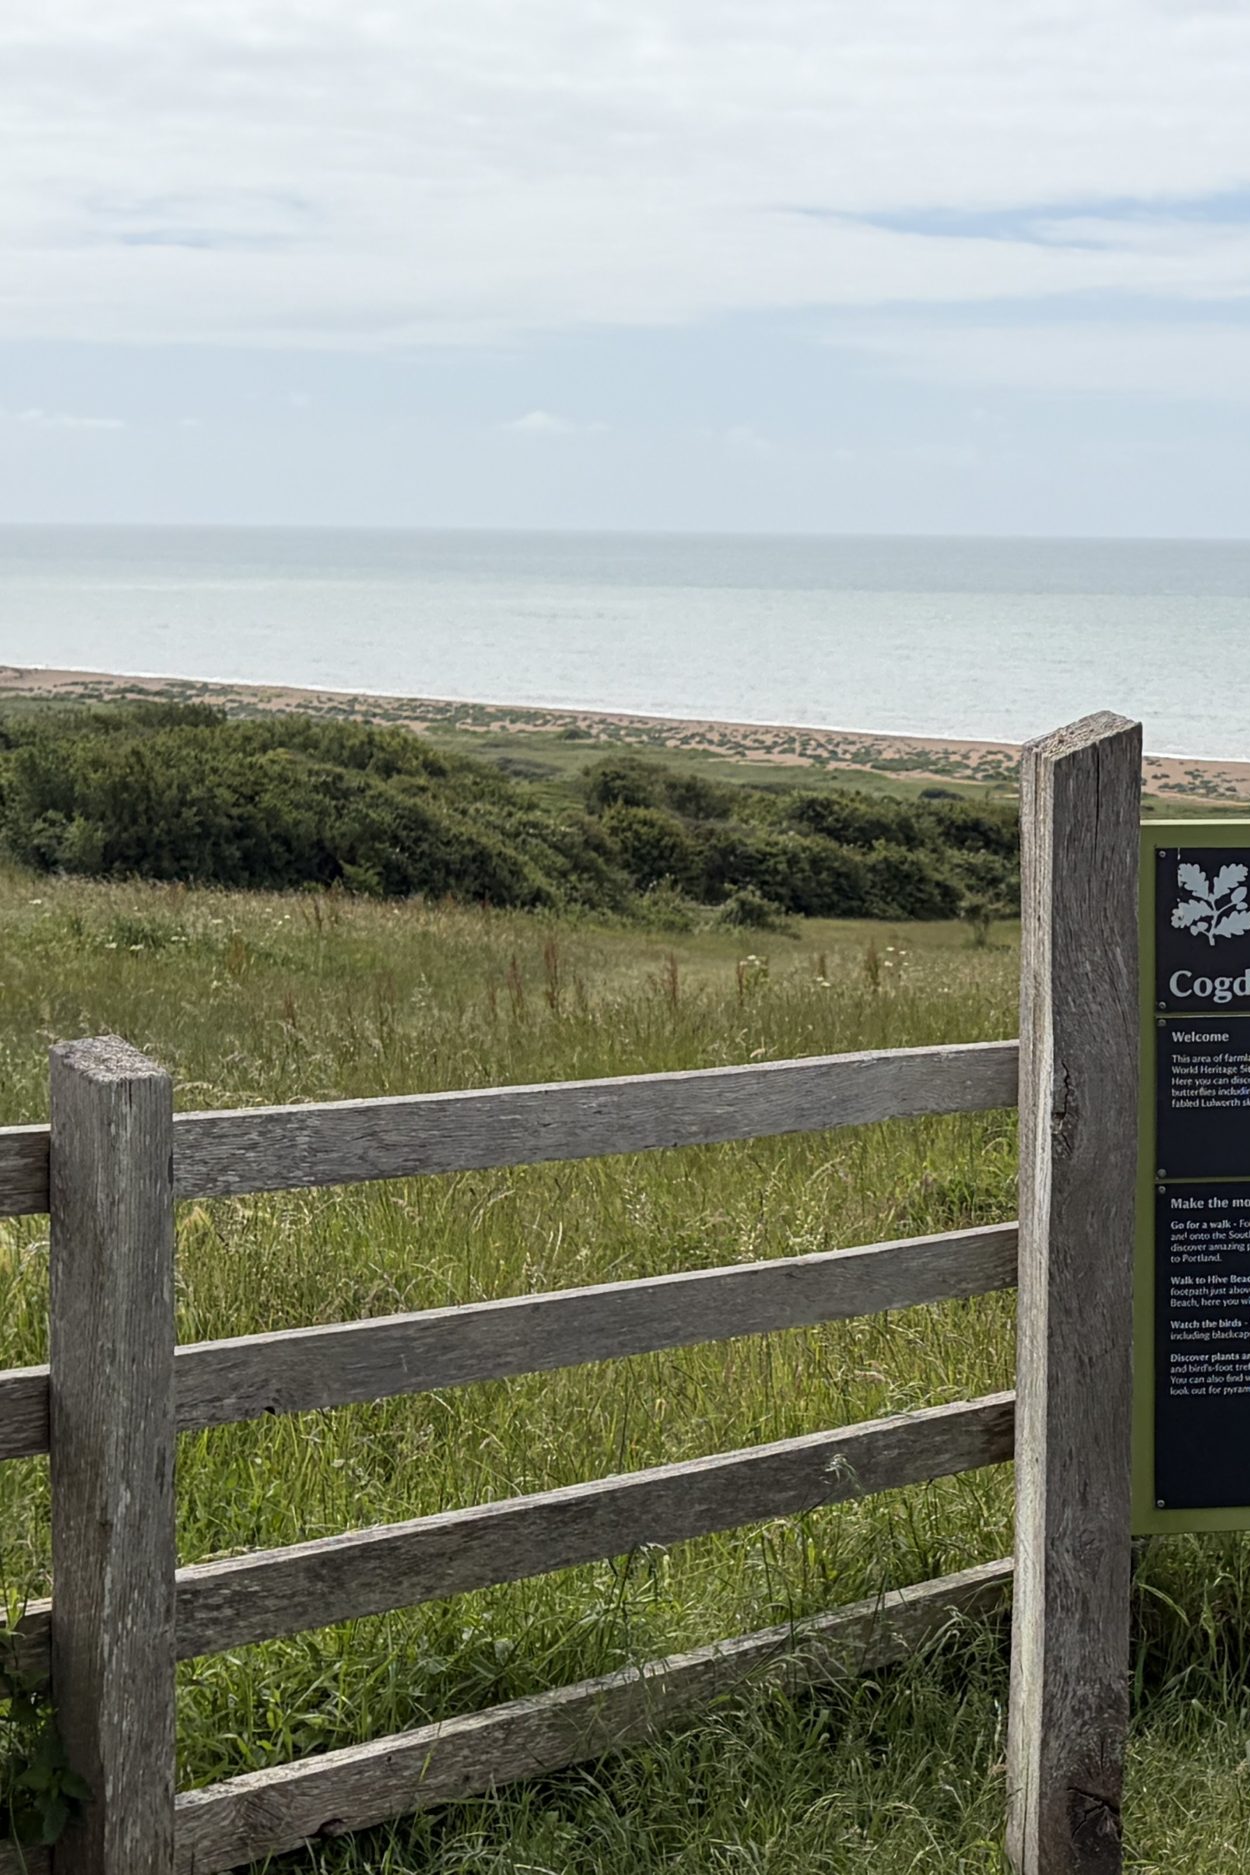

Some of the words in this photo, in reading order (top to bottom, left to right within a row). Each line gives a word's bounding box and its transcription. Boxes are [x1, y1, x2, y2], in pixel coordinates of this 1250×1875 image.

[1172, 1031, 1229, 1042] Welcome
[1172, 1053, 1190, 1062] This
[1212, 1053, 1222, 1062] of
[1172, 1065, 1198, 1074] World
[1199, 1064, 1238, 1075] Heritage
[1172, 1076, 1193, 1085] Here
[1194, 1078, 1211, 1086] you
[1172, 1086, 1216, 1096] butterflies
[1172, 1098, 1199, 1107] fabled
[1200, 1098, 1240, 1107] Lulworth
[1171, 1197, 1205, 1209] Make
[1207, 1197, 1229, 1208] the
[1171, 1221, 1184, 1229] Go
[1185, 1220, 1200, 1229] for
[1208, 1220, 1231, 1228] walk
